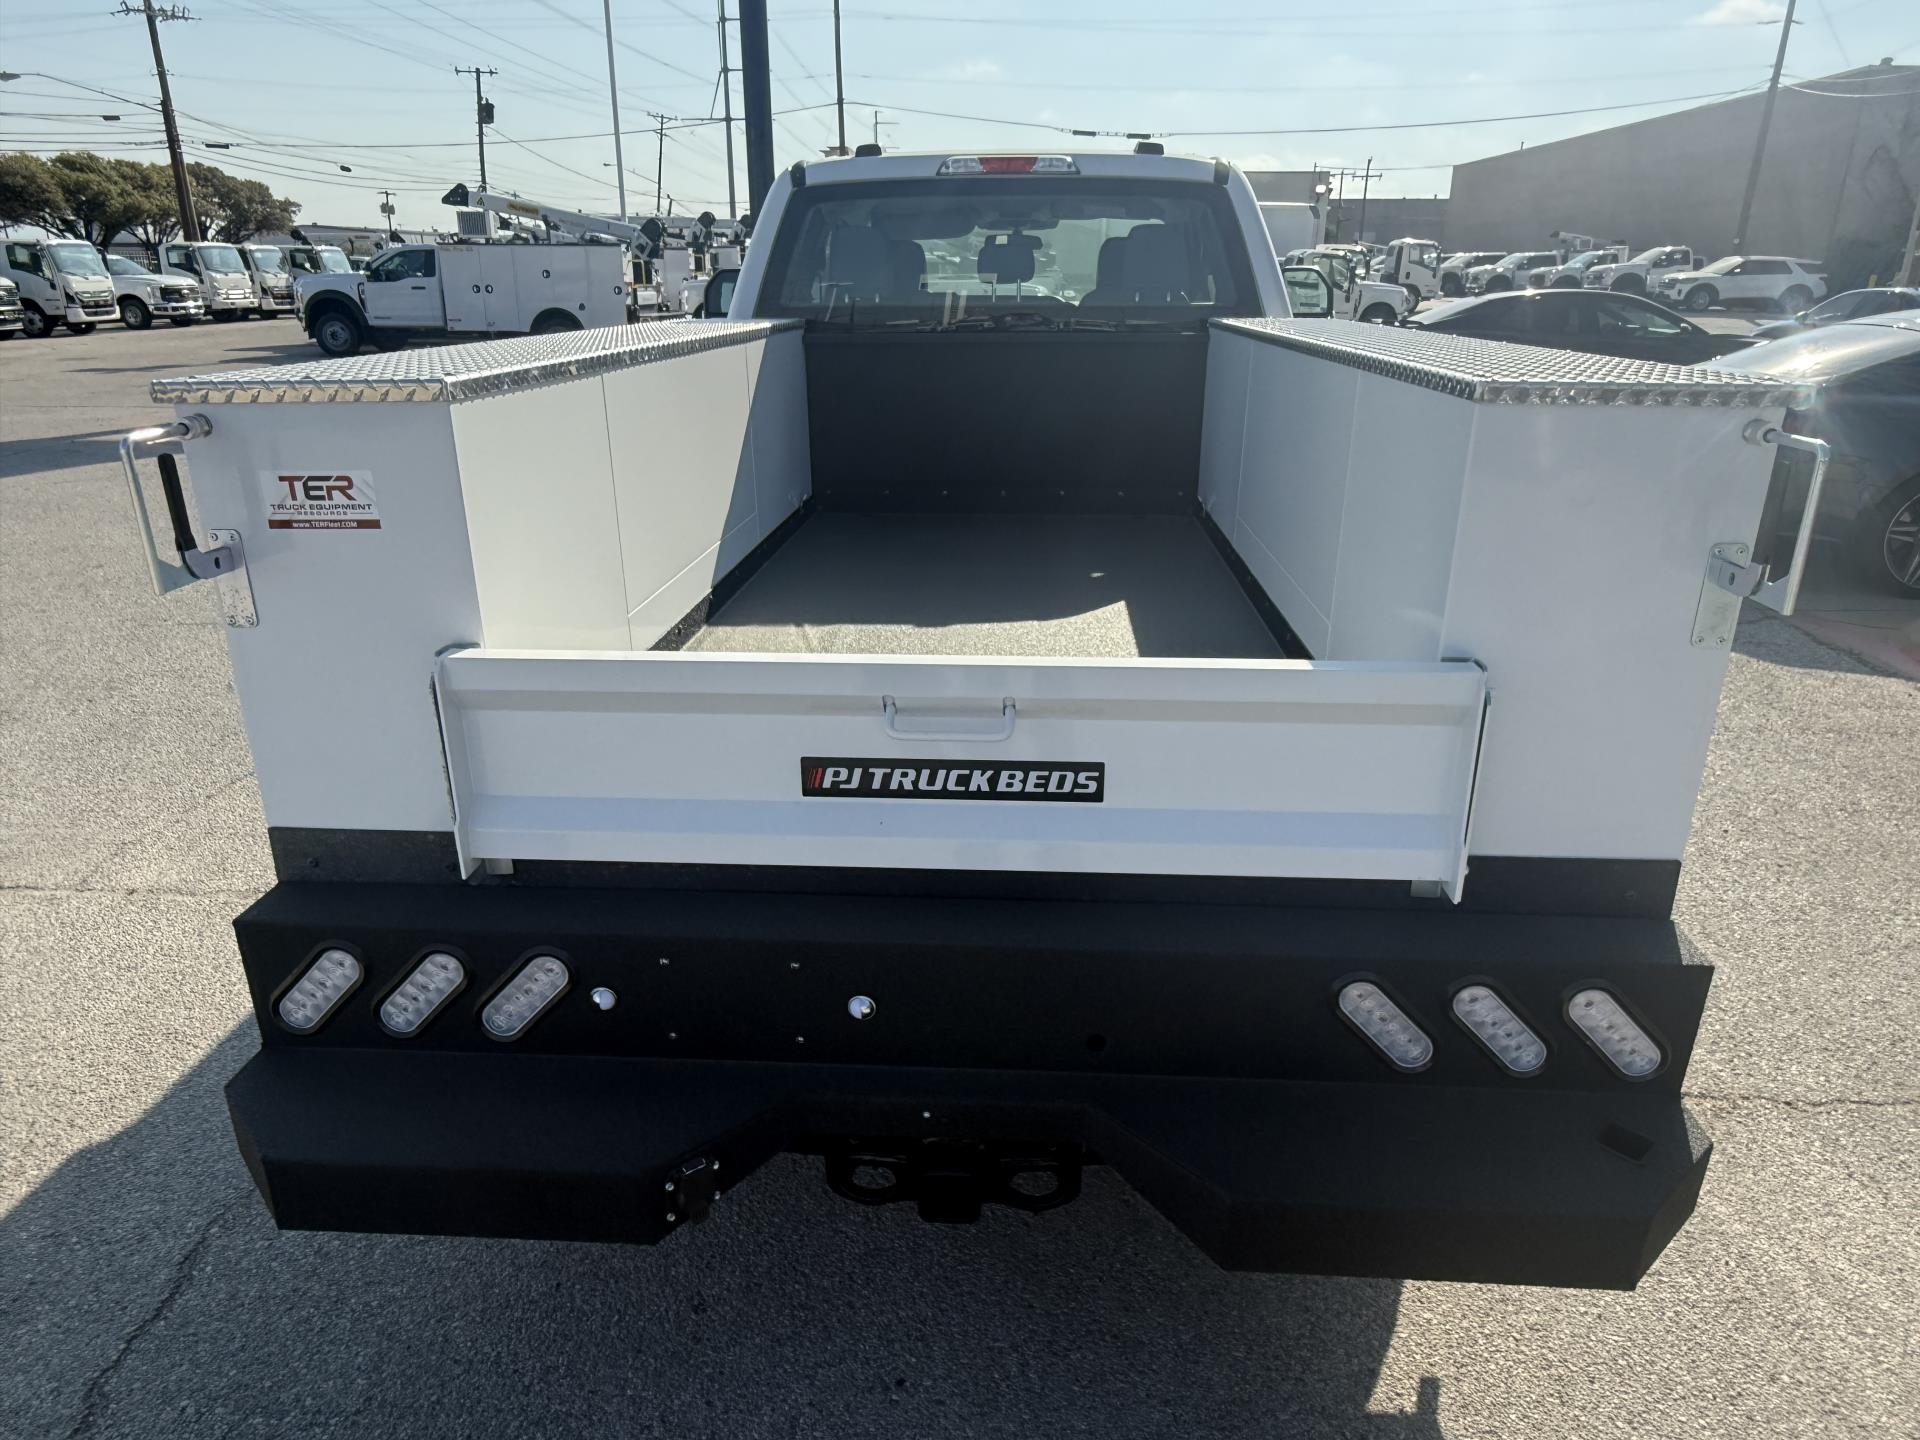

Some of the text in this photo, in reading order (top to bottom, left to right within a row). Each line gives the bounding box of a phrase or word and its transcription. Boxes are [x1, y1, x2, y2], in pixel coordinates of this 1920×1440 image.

[278, 475, 357, 501] TER
[270, 503, 372, 511] TRUCK EQUIPMENT
[821, 767, 1100, 794] PJ TRUCK BEDS
